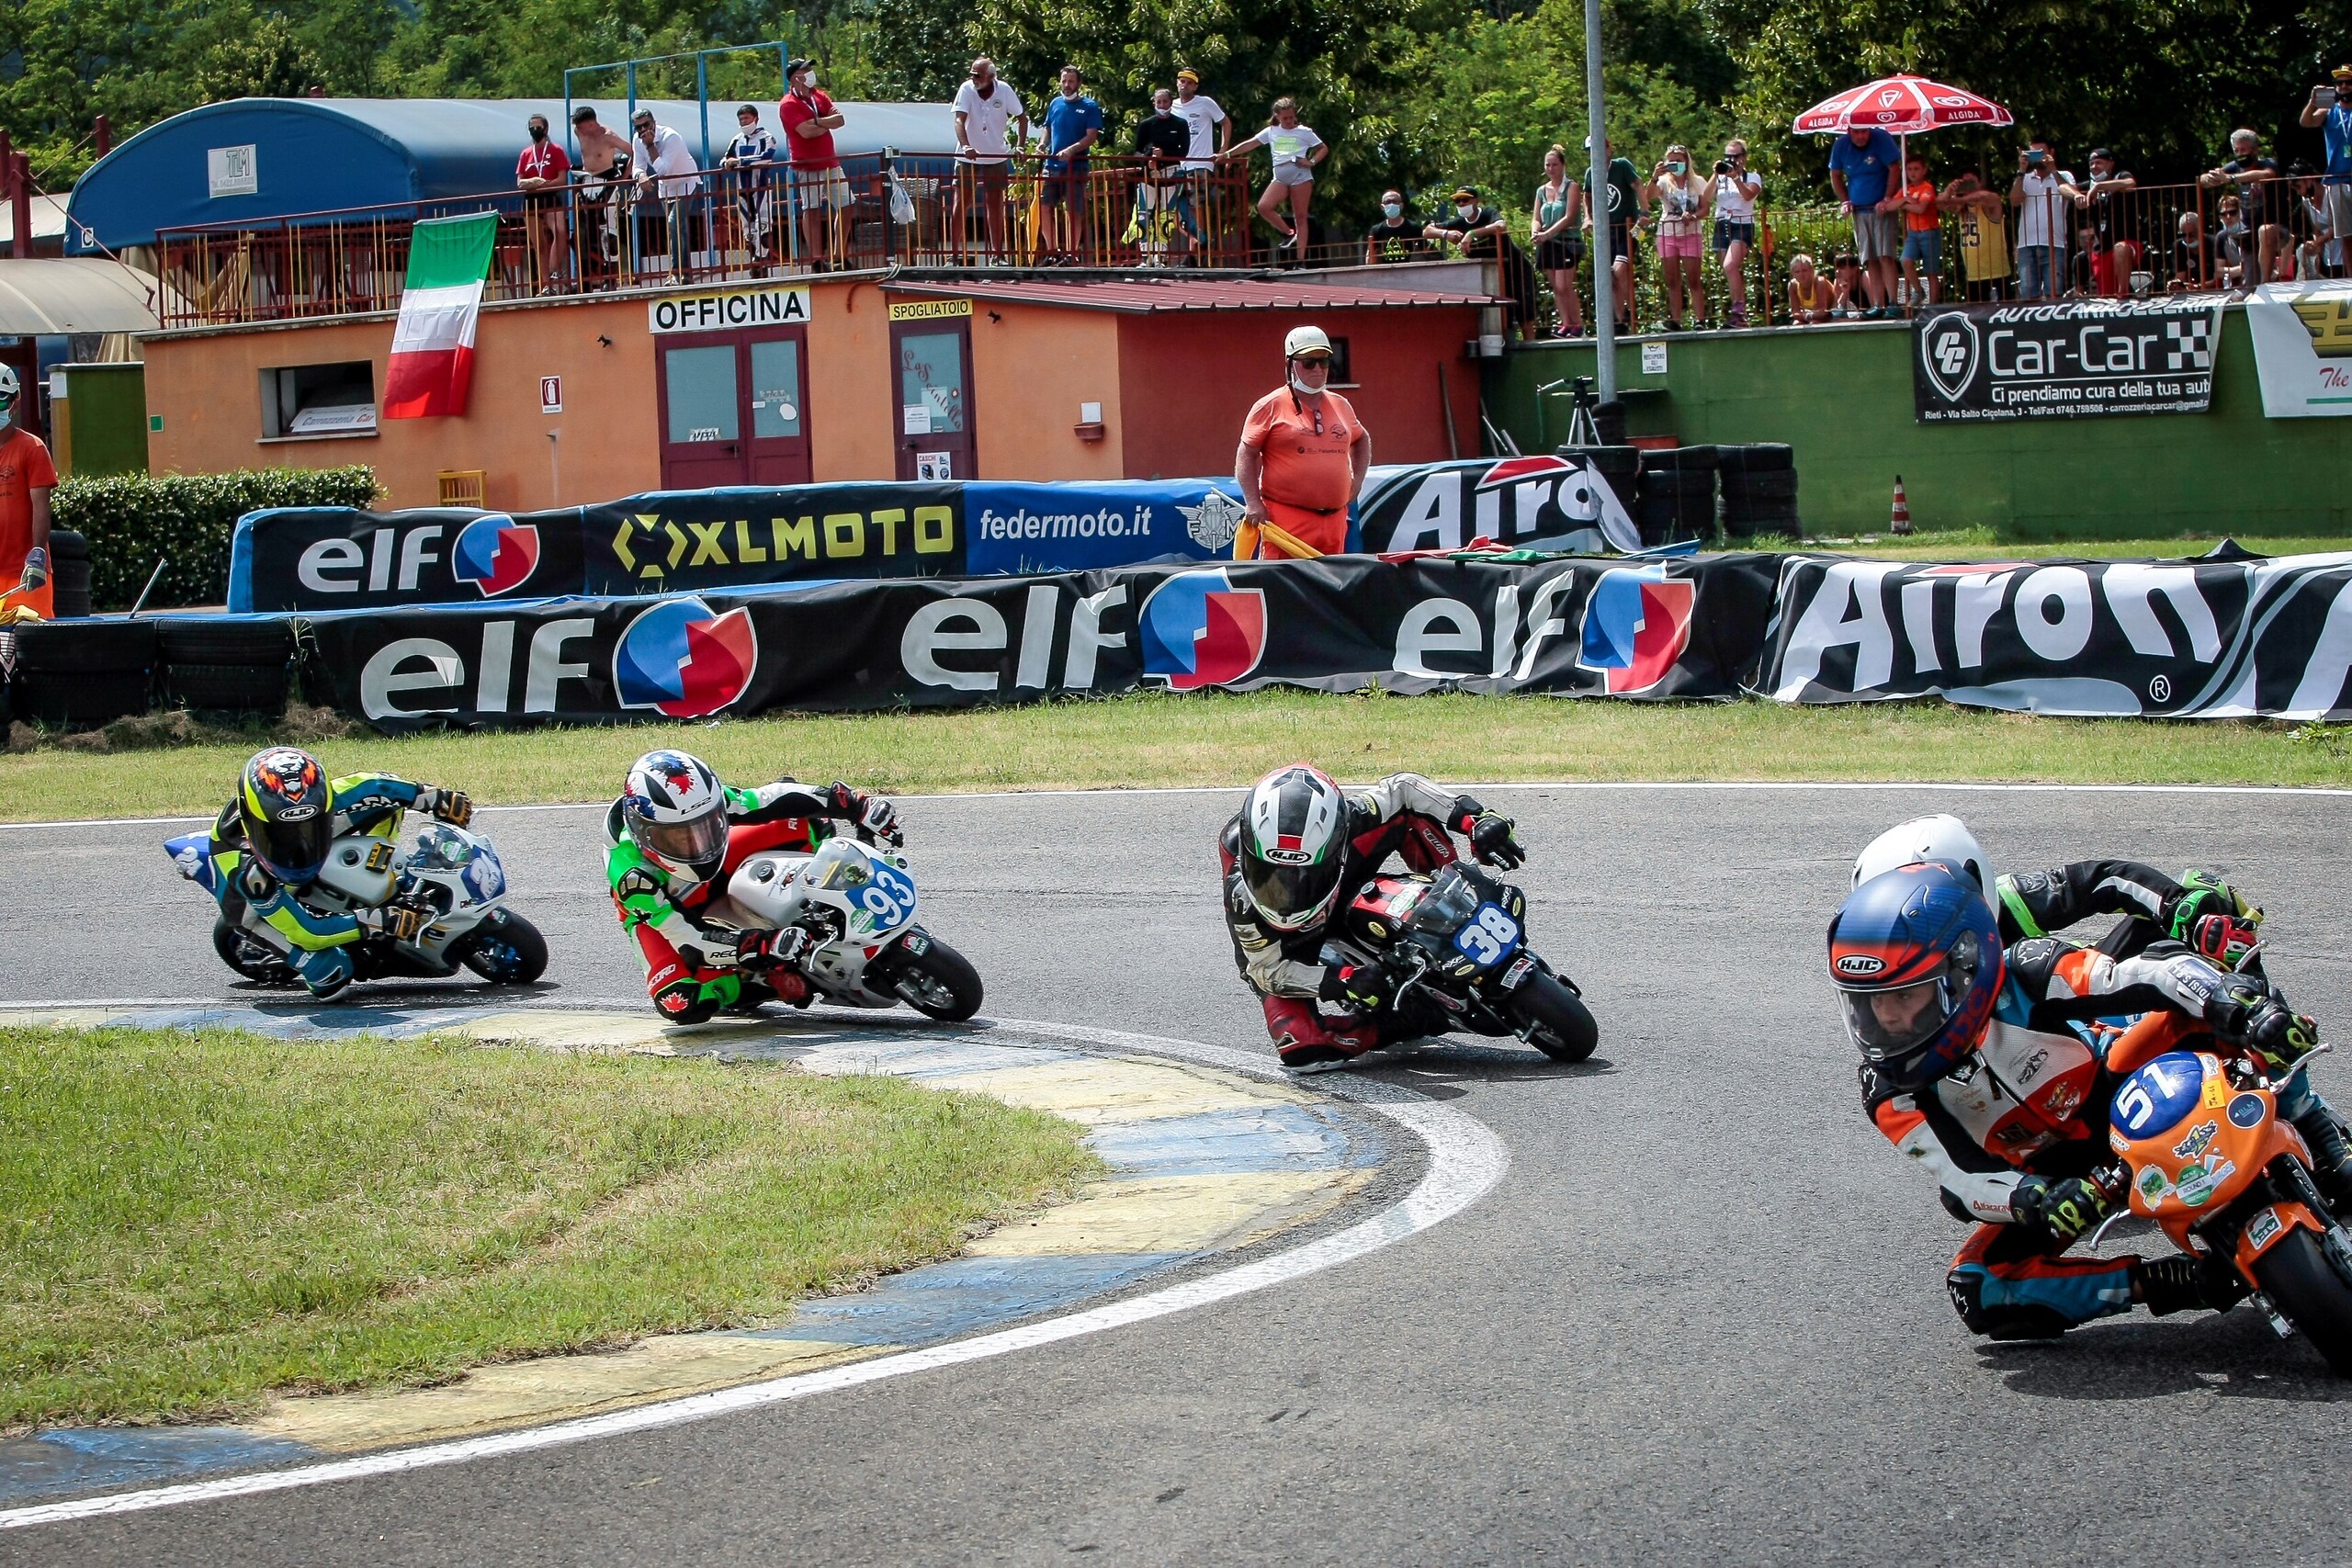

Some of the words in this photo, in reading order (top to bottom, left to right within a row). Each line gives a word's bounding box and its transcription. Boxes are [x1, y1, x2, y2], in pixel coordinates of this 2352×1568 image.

[1808, 118, 1834, 128] ALGIDA
[1948, 110, 1981, 120] ALGIDA
[226, 148, 250, 178] TLM
[656, 291, 804, 329] OFFICINA
[893, 300, 968, 319] SPOGLIATOIO
[1988, 325, 2158, 377] Car-Car
[1992, 387, 2005, 402] Ci
[2008, 383, 2081, 405] prendiamo
[2086, 386, 2116, 399] cura
[2120, 381, 2153, 397] della
[2156, 381, 2181, 396] tua
[2319, 367, 2350, 389] The
[1925, 411, 1941, 419] Rieti
[1948, 410, 1960, 419] Via
[1962, 409, 1981, 418] Salto
[2029, 406, 2055, 415] Tel/Fax
[686, 505, 954, 566] XLMOTO
[979, 505, 1152, 540] federmoto.it
[298, 525, 444, 592] elf
[900, 584, 1127, 691] elf
[1391, 569, 1575, 681] elf
[1773, 561, 2222, 701] Airon
[360, 617, 595, 720] elf
[284, 807, 312, 818] HJC
[681, 796, 712, 816] LS2
[1272, 851, 1306, 861] HJC
[862, 870, 915, 926] 93
[1459, 907, 1518, 964] 38
[1838, 958, 1880, 970] HJC
[2116, 1062, 2176, 1131] 51
[2182, 1180, 2202, 1193] ROUND
